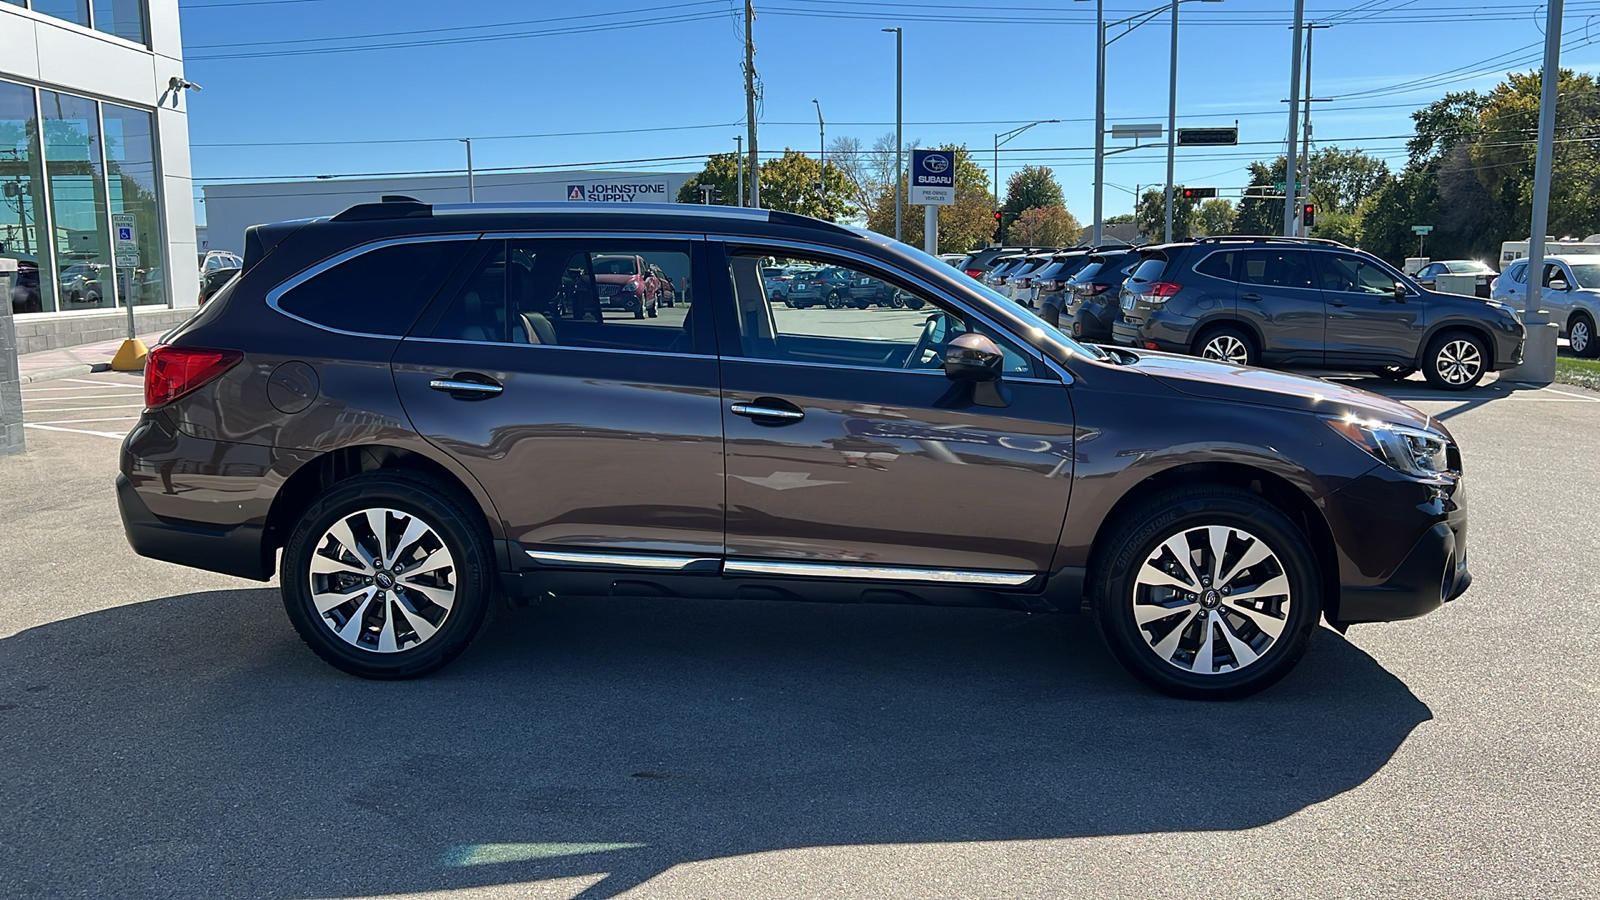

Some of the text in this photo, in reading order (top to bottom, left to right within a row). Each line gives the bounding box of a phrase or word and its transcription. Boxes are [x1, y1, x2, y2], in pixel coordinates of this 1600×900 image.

[918, 175, 952, 184] SUBARU
[587, 184, 665, 194] JOHNSTONE
[588, 193, 636, 202] SUPPLY
[1116, 510, 1177, 569] BRIDGESTONE
